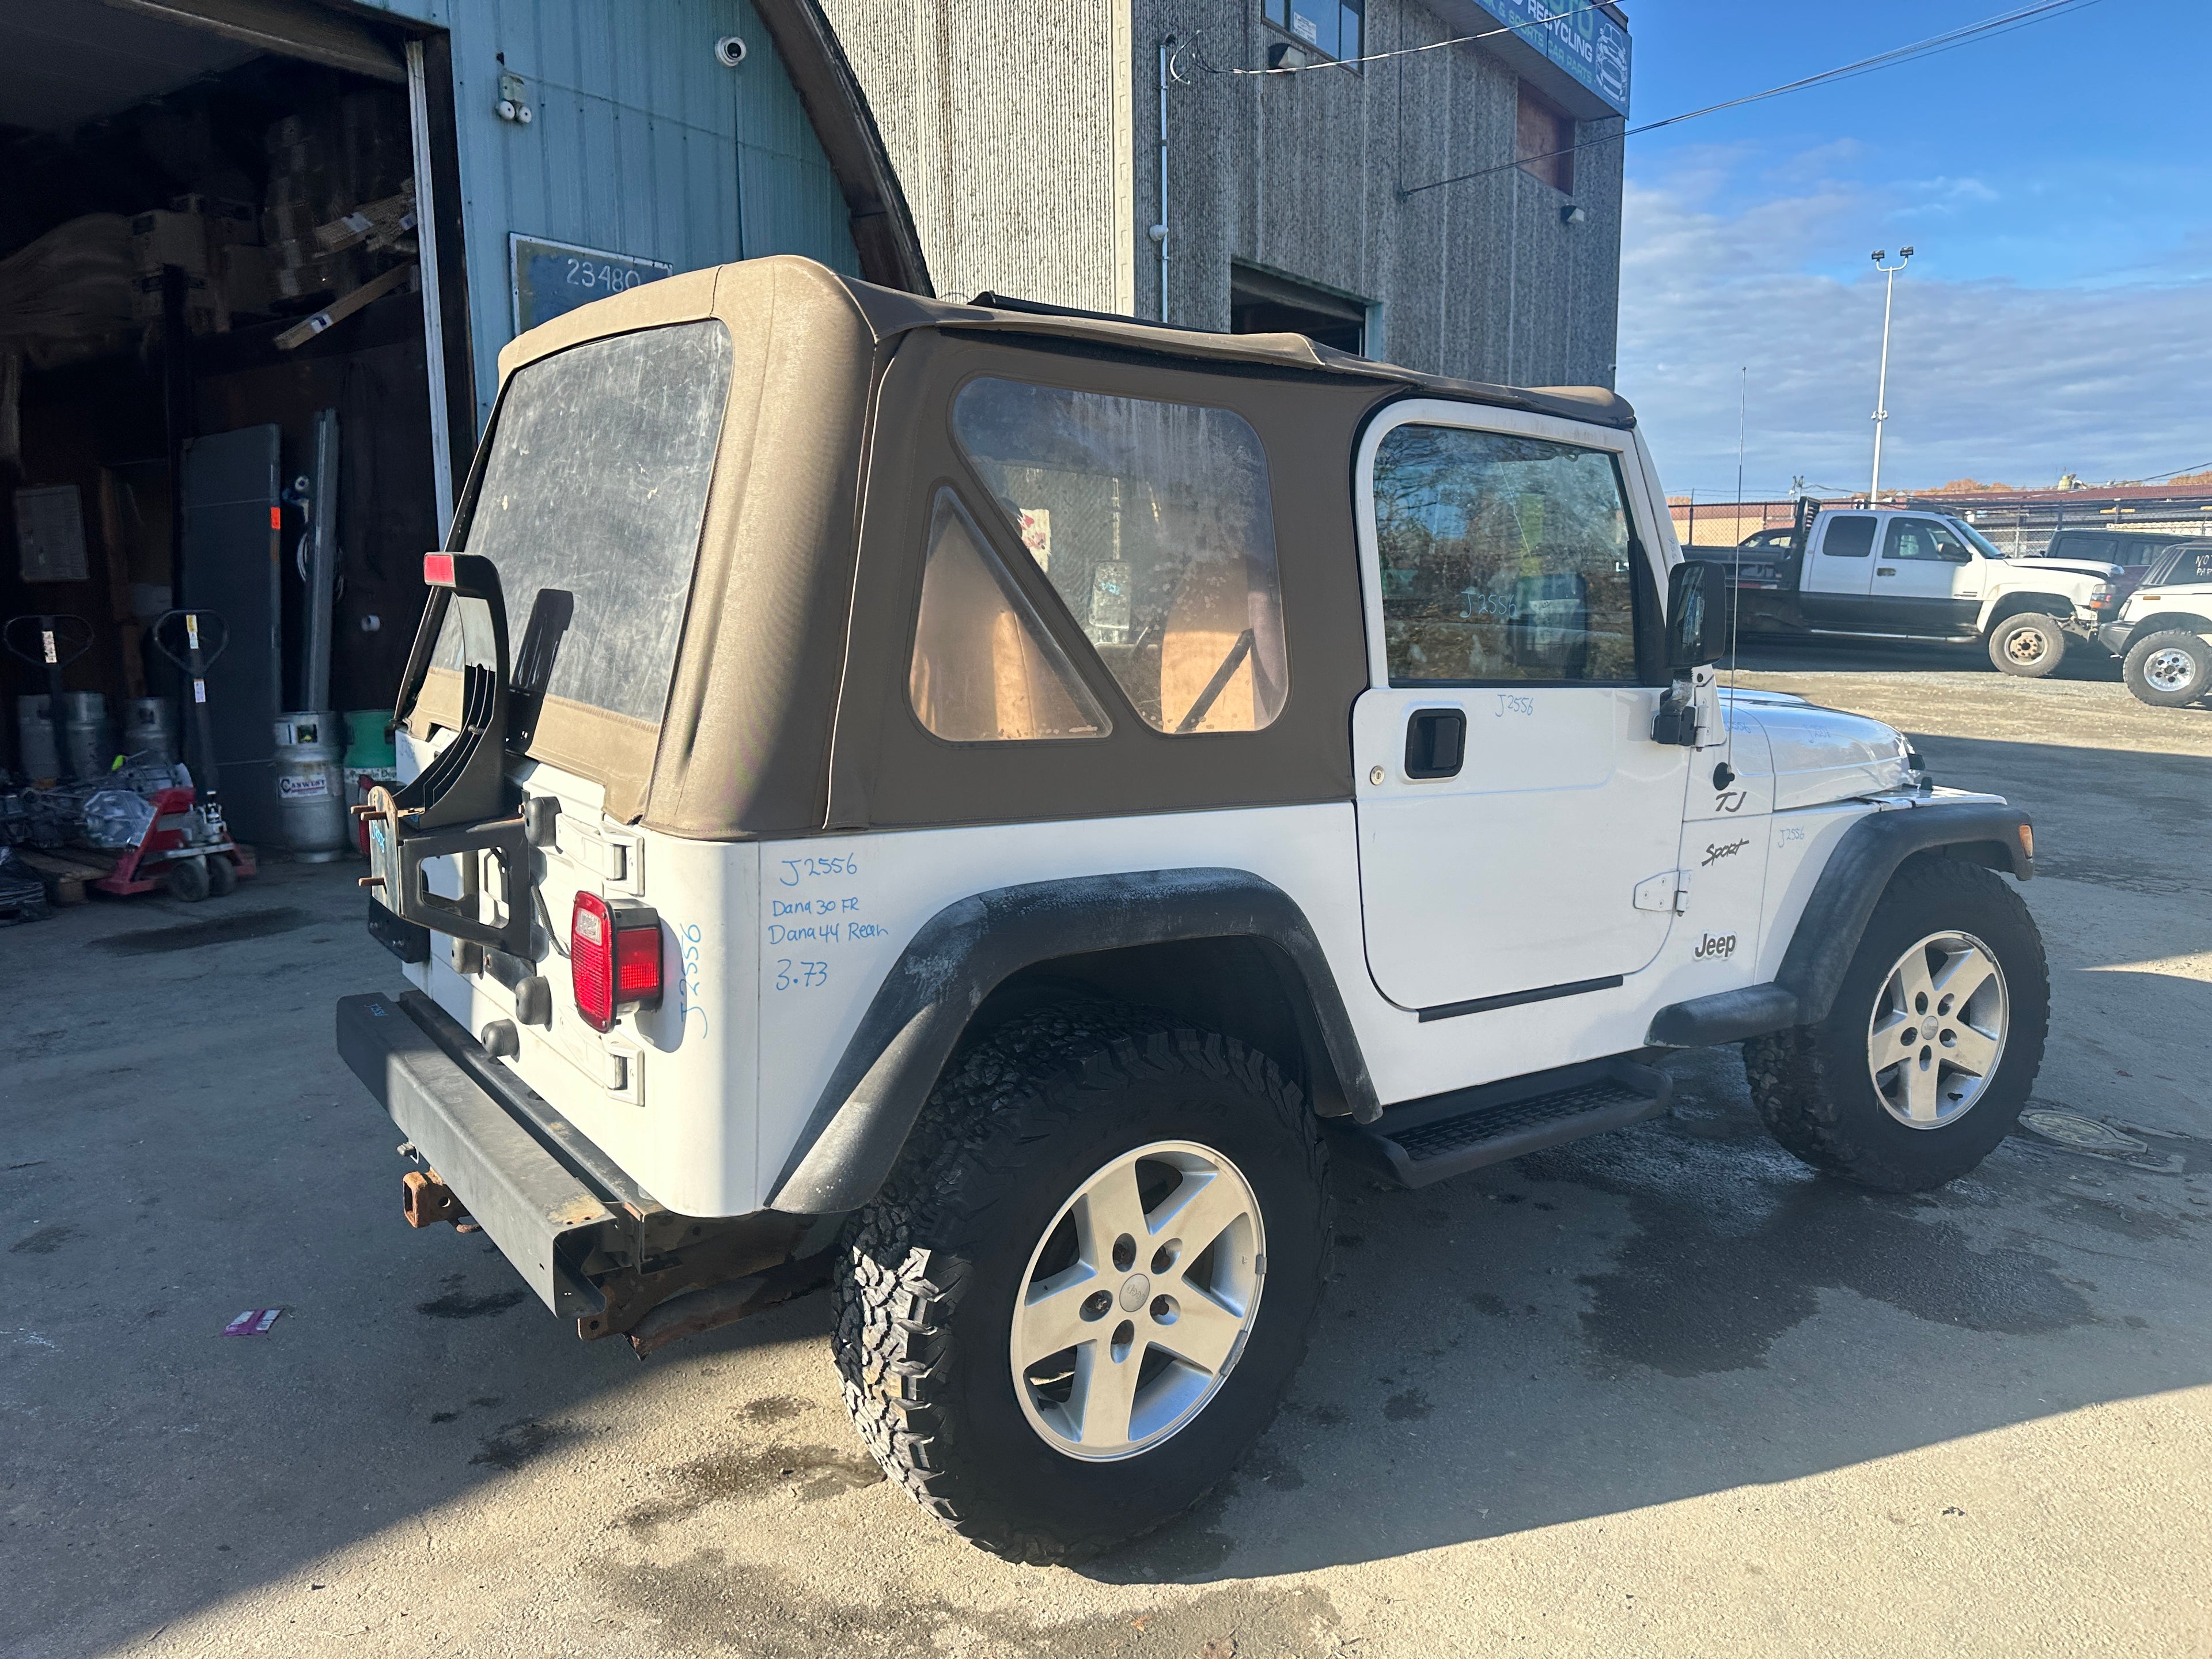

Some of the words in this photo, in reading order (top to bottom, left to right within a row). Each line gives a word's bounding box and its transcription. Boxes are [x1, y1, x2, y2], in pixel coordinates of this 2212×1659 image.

[1528, 0, 1593, 63] RECYCLING
[1509, 10, 1544, 47] SPORTS
[1548, 40, 1564, 64] CAR
[1567, 55, 1592, 84] PARTS
[567, 258, 641, 292] 23480
[2195, 555, 2212, 567] NO
[1460, 591, 1517, 618] J2556
[1495, 694, 1533, 717] J2556
[1715, 791, 1747, 813] TJ
[1778, 826, 1805, 849] J2556
[1701, 838, 1749, 867] Sport
[780, 853, 857, 886] J2556
[772, 900, 812, 917] Dana
[816, 900, 836, 915] 30
[842, 897, 860, 913] FR
[768, 925, 815, 945] Dana
[819, 923, 839, 943] 44
[1695, 932, 1736, 959] Jeep
[679, 923, 708, 1039] J2556
[776, 959, 828, 991] 3.73
